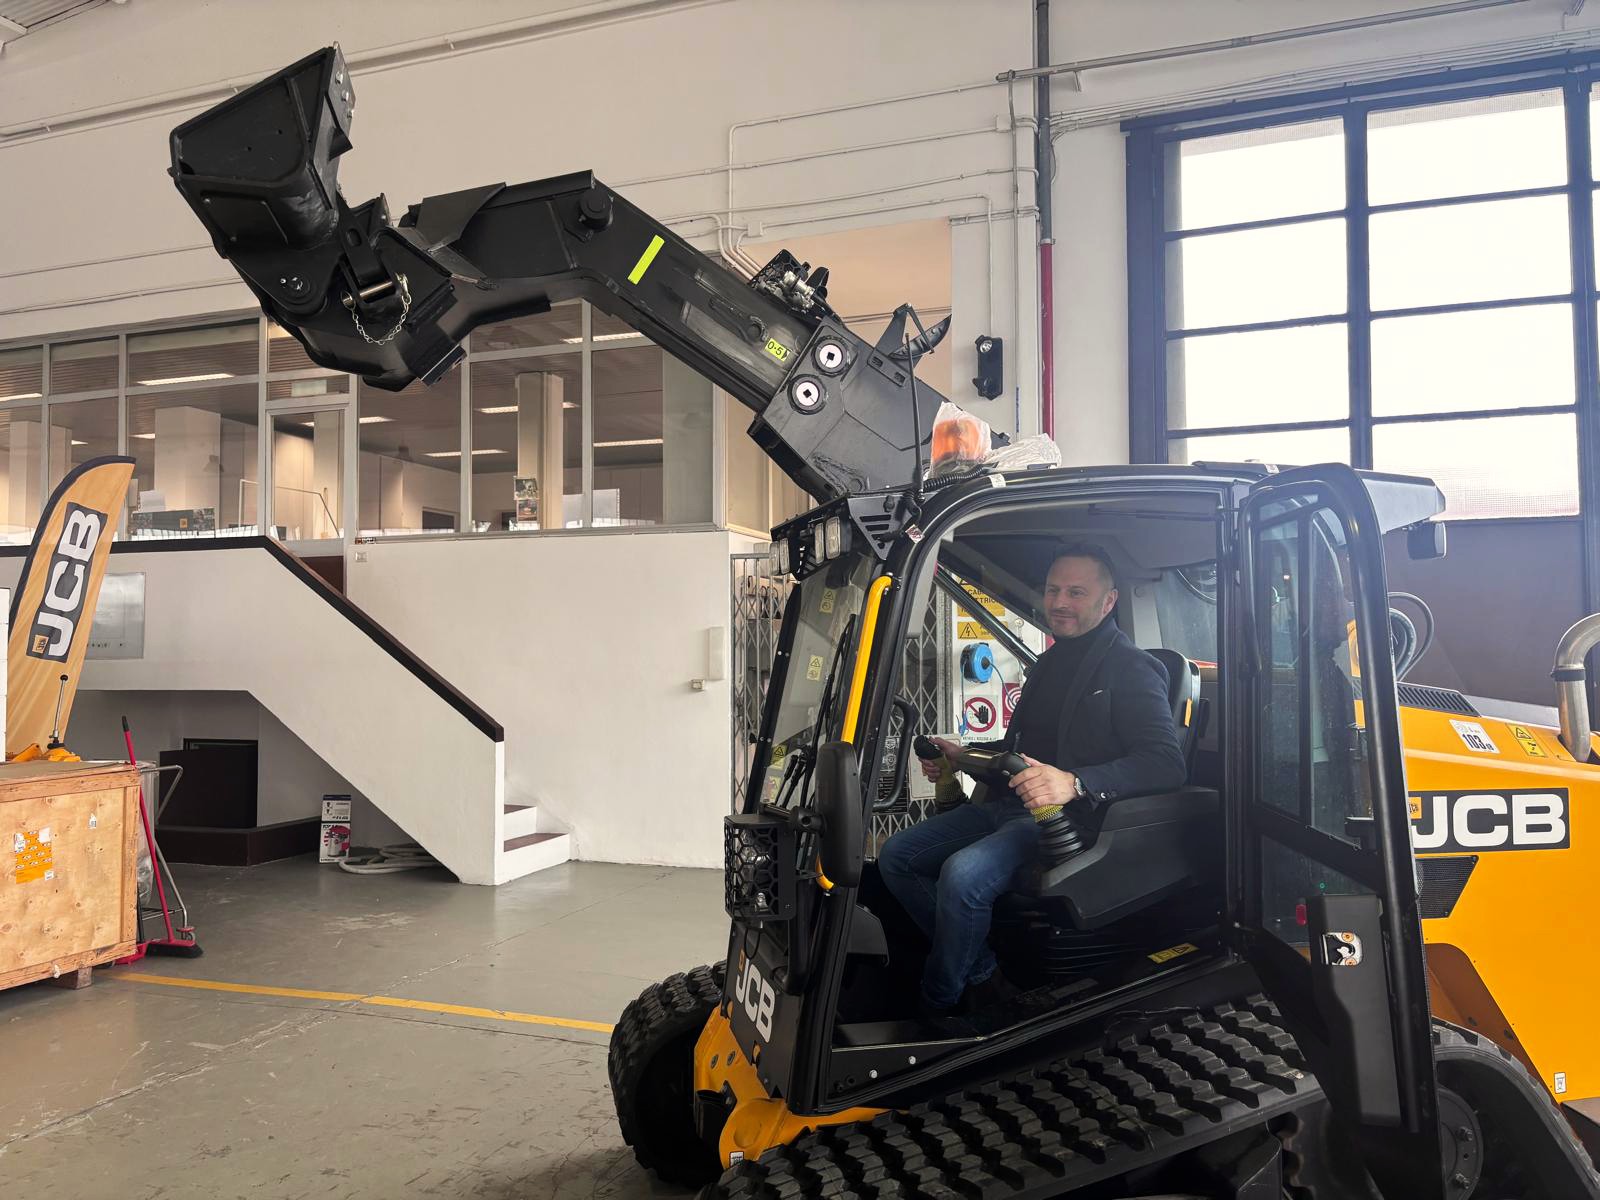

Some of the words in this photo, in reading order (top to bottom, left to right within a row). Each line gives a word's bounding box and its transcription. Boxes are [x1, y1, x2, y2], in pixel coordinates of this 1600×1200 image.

[38, 509, 101, 656] JCB
[1411, 793, 1566, 849] JCB
[735, 958, 776, 1043] JCB
